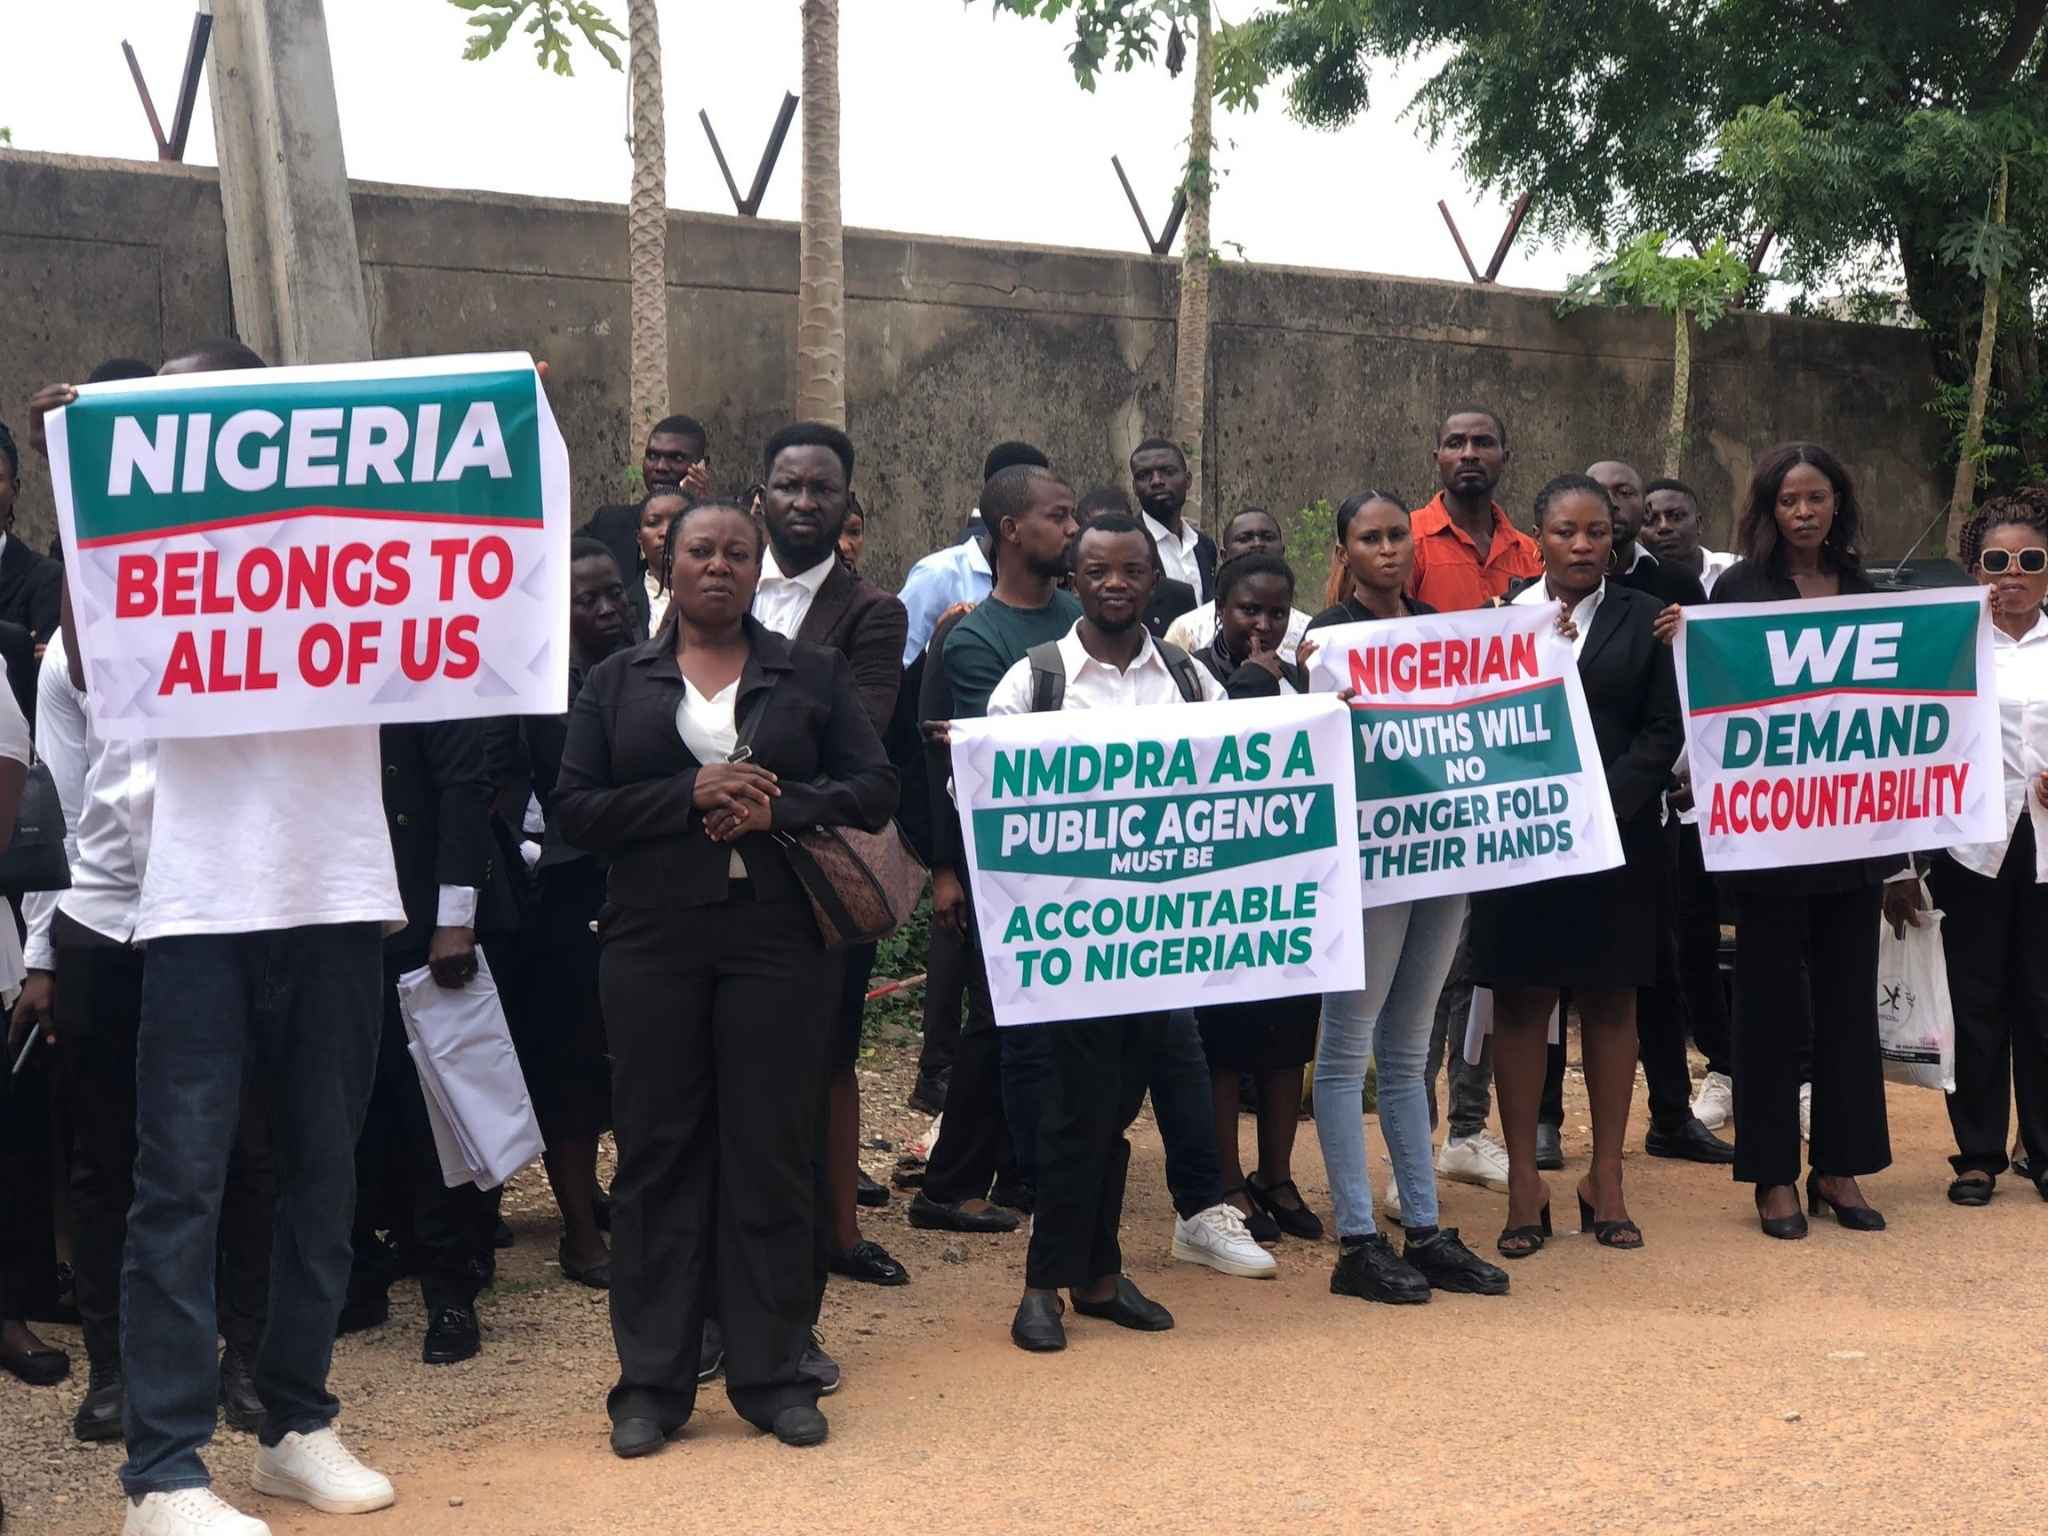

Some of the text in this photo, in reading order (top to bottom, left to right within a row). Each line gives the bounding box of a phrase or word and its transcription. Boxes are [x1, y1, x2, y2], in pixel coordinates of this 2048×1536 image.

[108, 402, 512, 496] NIGERIA
[116, 536, 513, 618] BELONGS TO
[159, 615, 480, 695] ALL OF US
[1348, 633, 1538, 695] NIGERIAN
[1766, 623, 1903, 686] WE
[1360, 703, 1551, 763] YOUTHS WILL
[1722, 703, 1949, 769] DEMAND
[992, 730, 1315, 799] NMDPRA AS A
[1445, 756, 1486, 784] NO
[1001, 793, 1316, 857] PUBLIC AGENCY
[1357, 783, 1569, 841] LONGER FOLD
[1709, 763, 1969, 835] ACCOUNTABILITY
[1110, 846, 1214, 874] MUST BE
[1359, 820, 1573, 880] THEIR HANDS
[1002, 882, 1319, 944] ACCOUNTABLE
[1016, 927, 1313, 987] TO NIGERIANS
